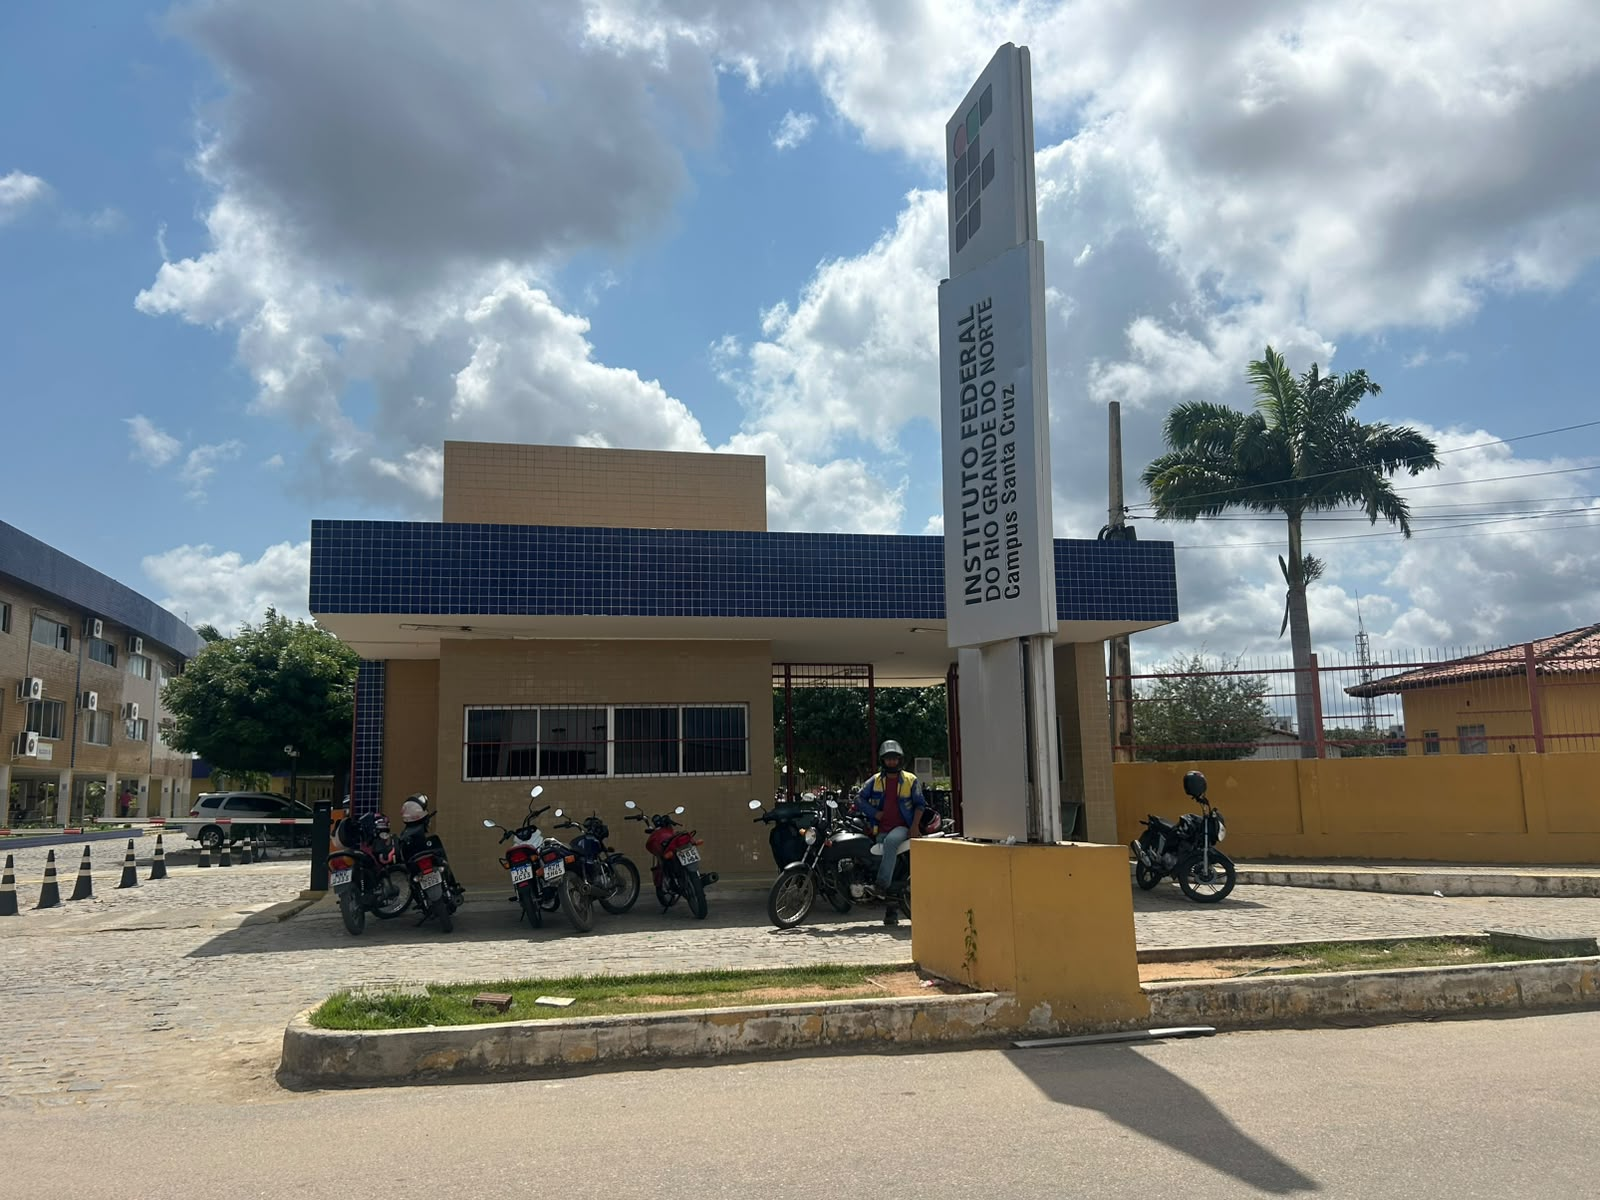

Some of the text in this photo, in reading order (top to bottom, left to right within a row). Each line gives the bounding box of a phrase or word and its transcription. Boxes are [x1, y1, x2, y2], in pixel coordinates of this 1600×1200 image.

[958, 304, 982, 605] INSTITUTO FEDERAL
[978, 296, 1001, 601] DO RIO GRANDE DO NORTE
[1000, 383, 1022, 599] Campus Santa Cruz
